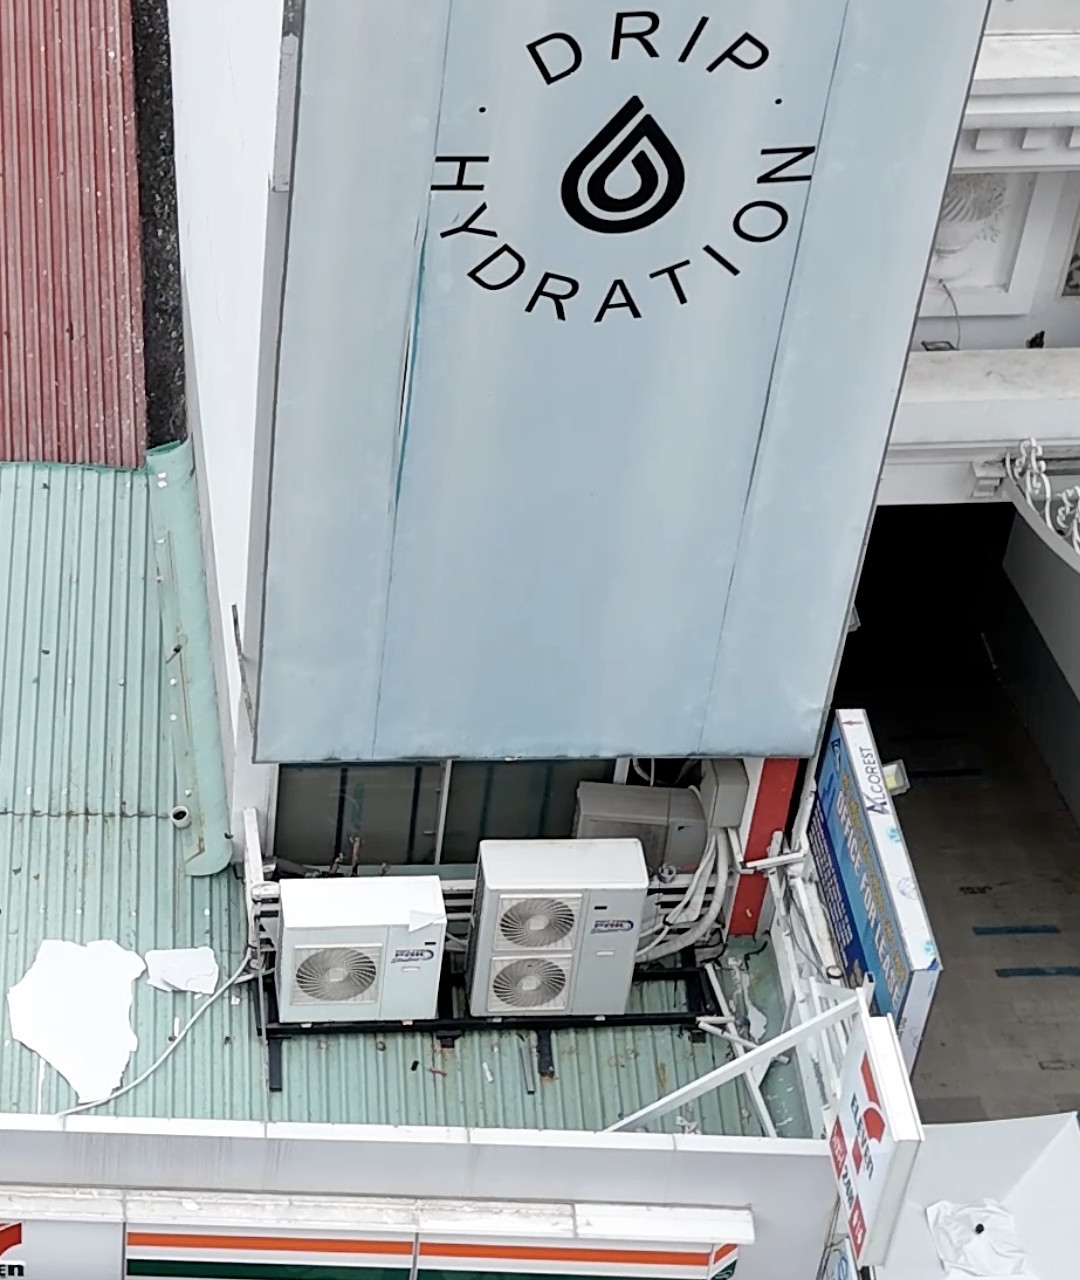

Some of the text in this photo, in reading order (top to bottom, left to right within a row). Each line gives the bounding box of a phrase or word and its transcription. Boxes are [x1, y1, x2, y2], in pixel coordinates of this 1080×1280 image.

[527, 11, 769, 85] DRIP
[431, 146, 816, 323] HYDRATION
[836, 790, 863, 876] OFFICE
[859, 872, 877, 928] FOR
[873, 921, 900, 1007] LEASE
